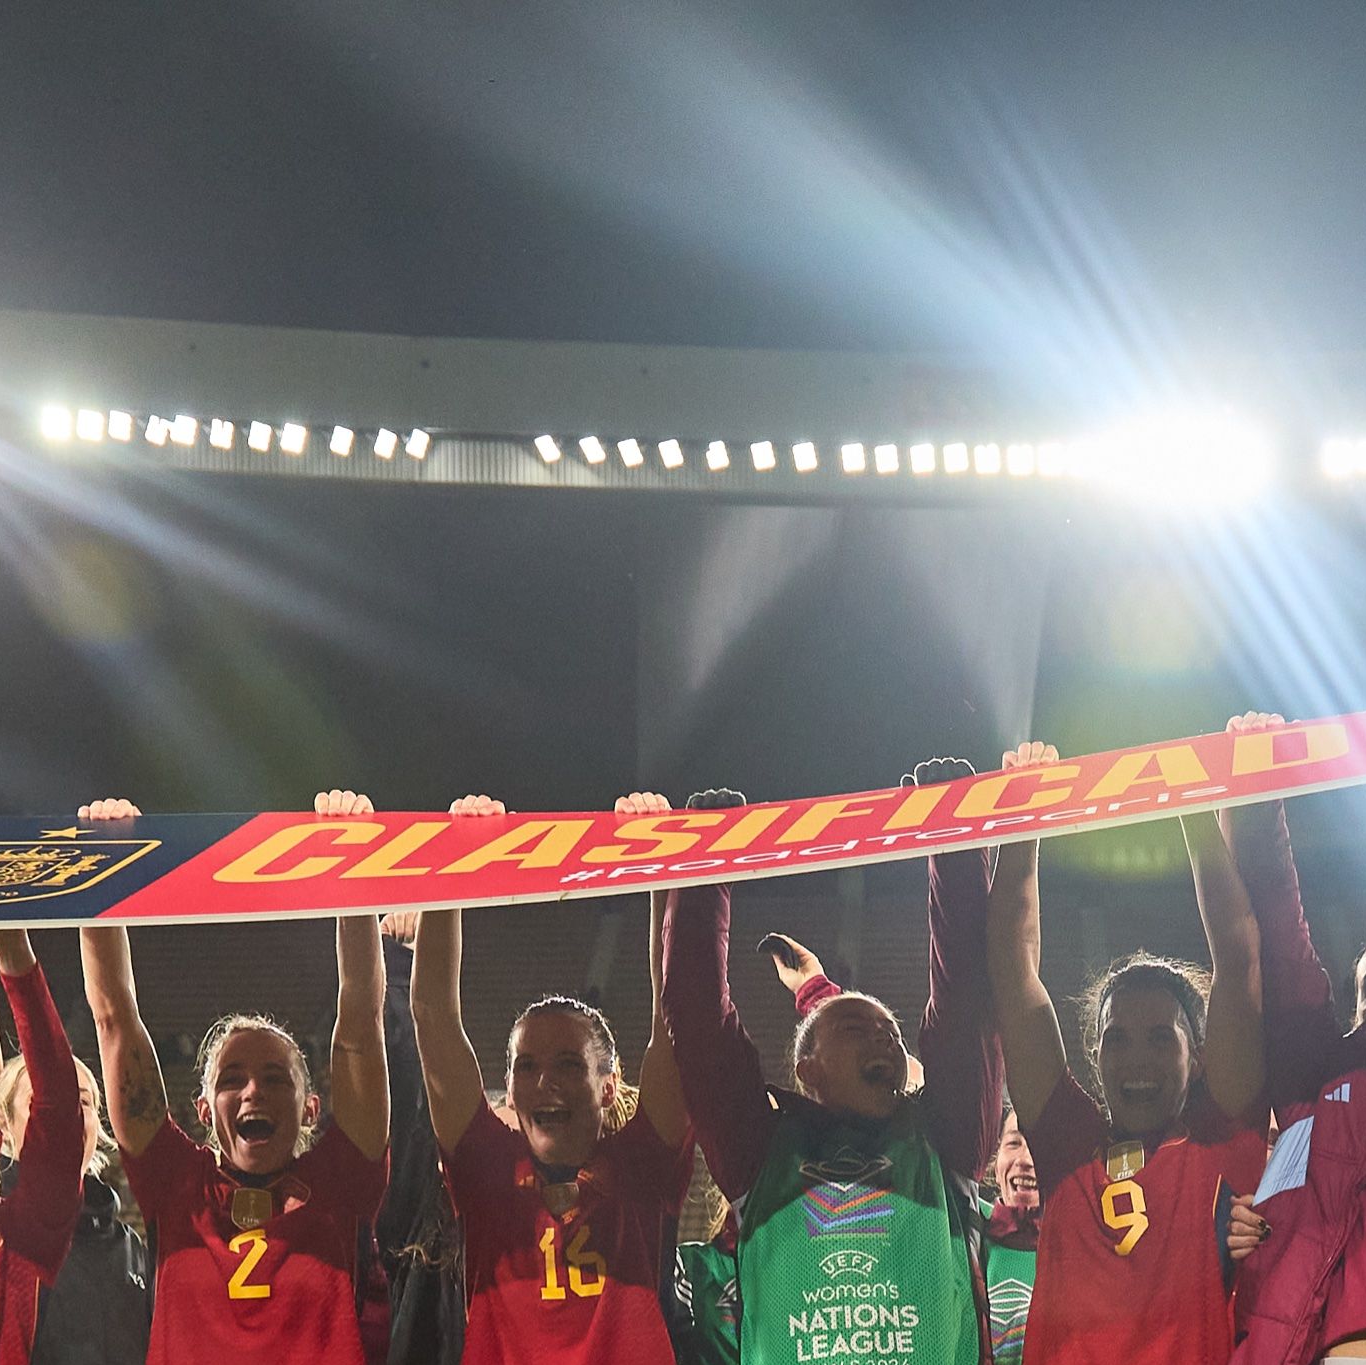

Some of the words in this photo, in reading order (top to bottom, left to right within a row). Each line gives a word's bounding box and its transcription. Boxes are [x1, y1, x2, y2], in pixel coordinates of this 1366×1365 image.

[1100, 1179, 1149, 1256] 9
[228, 1228, 271, 1299] 2
[539, 1225, 607, 1300] 16
[822, 1255, 874, 1275] UEFA
[802, 1280, 900, 1304] women's
[788, 1303, 920, 1337] NATIONS
[797, 1330, 914, 1362] LEAGUE
